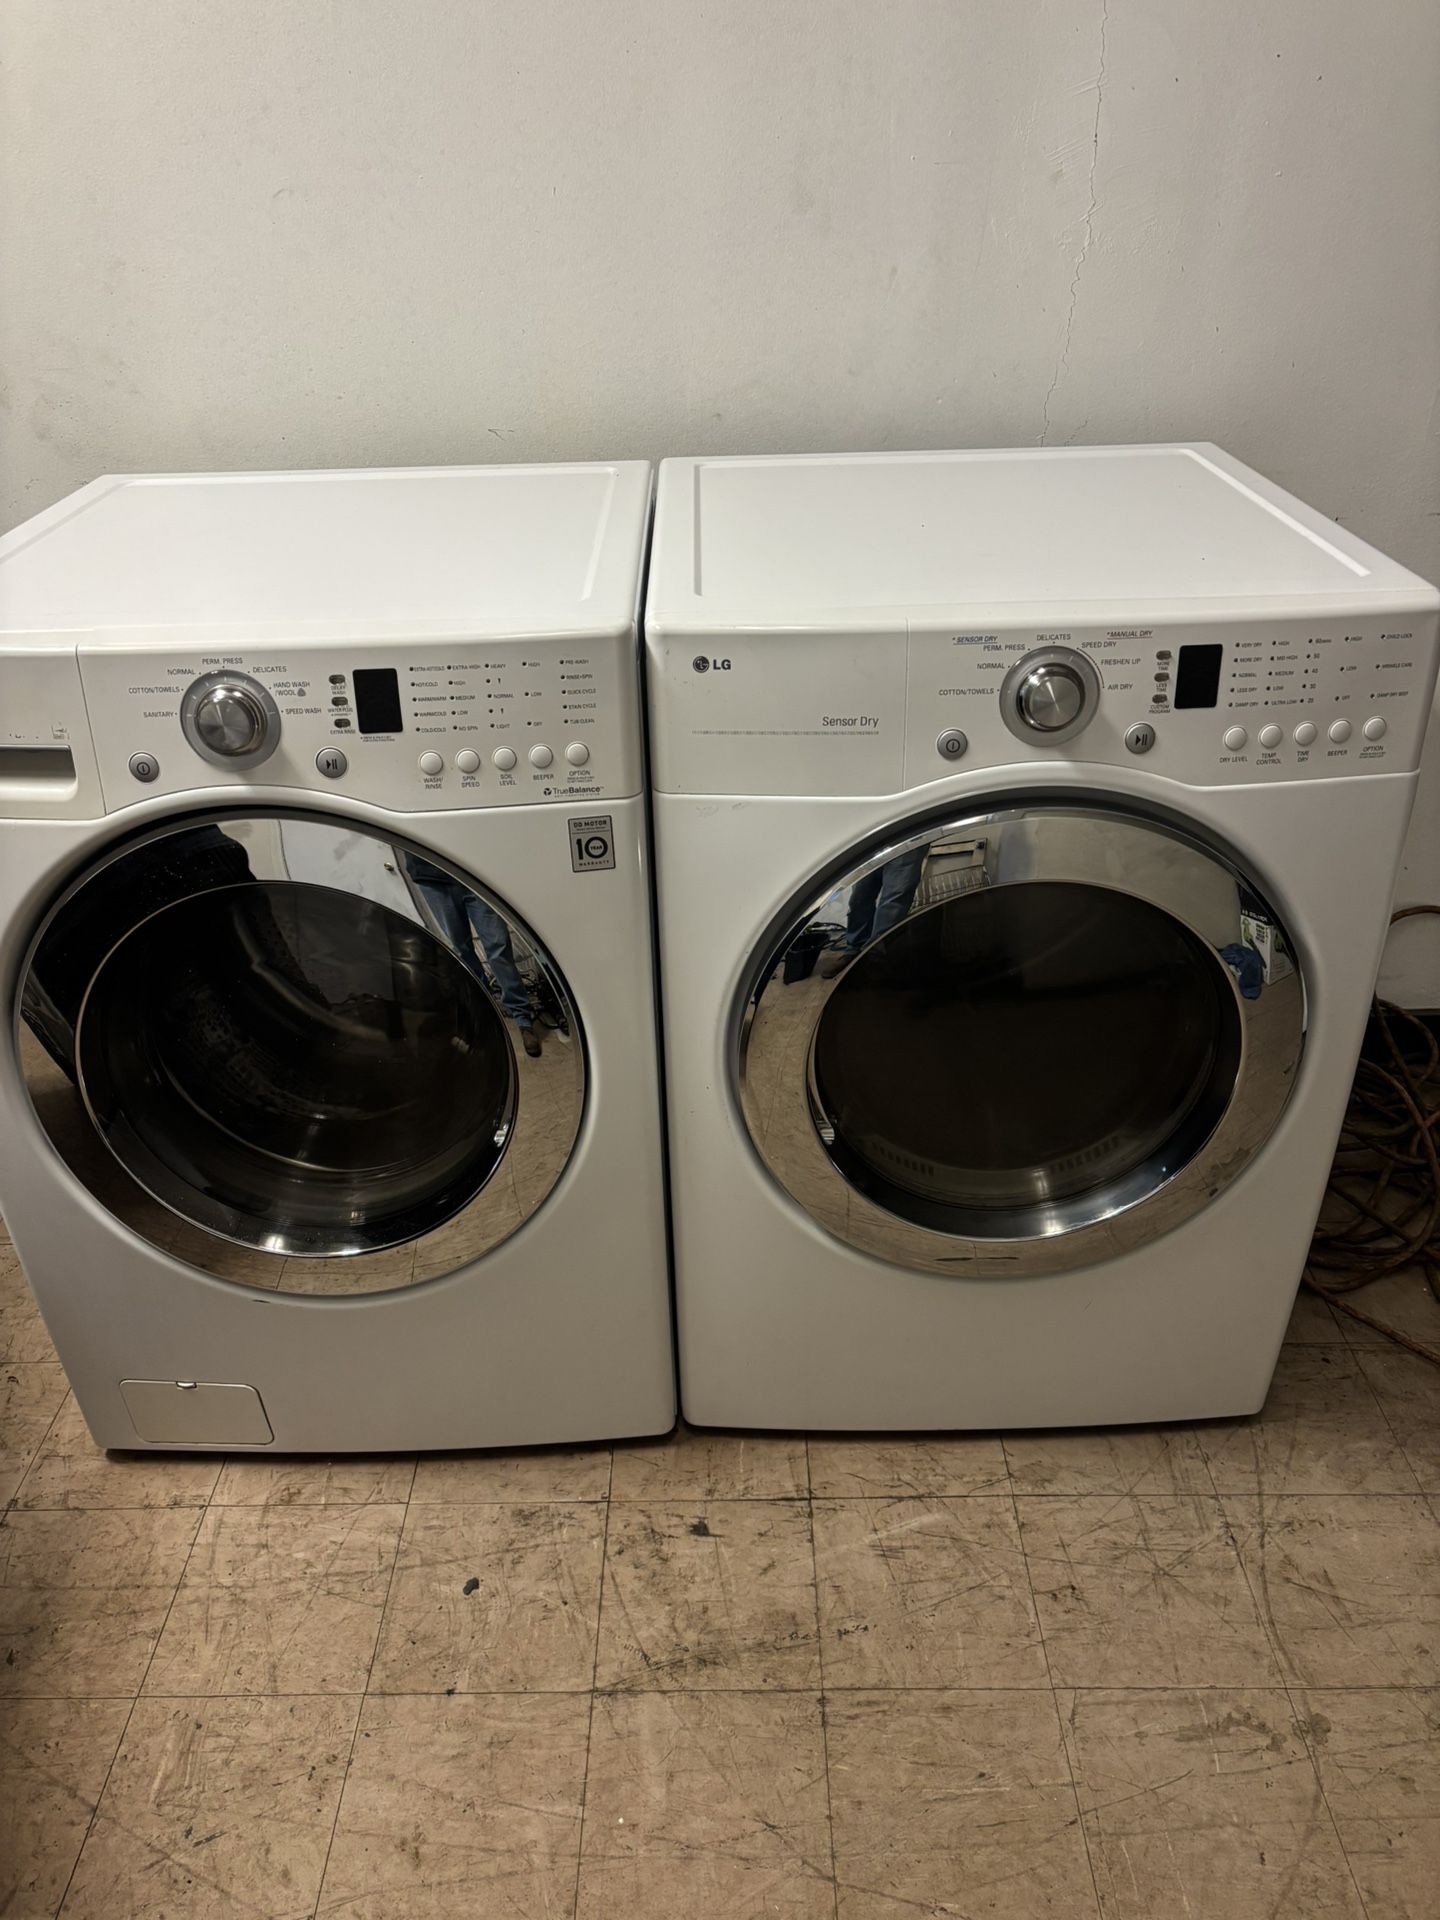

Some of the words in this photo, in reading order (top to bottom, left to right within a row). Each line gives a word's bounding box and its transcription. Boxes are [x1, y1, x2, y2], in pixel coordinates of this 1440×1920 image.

[713, 659, 731, 670] LG
[822, 716, 857, 726] Sensor
[860, 716, 879, 728] Dry
[576, 837, 608, 860] 10
